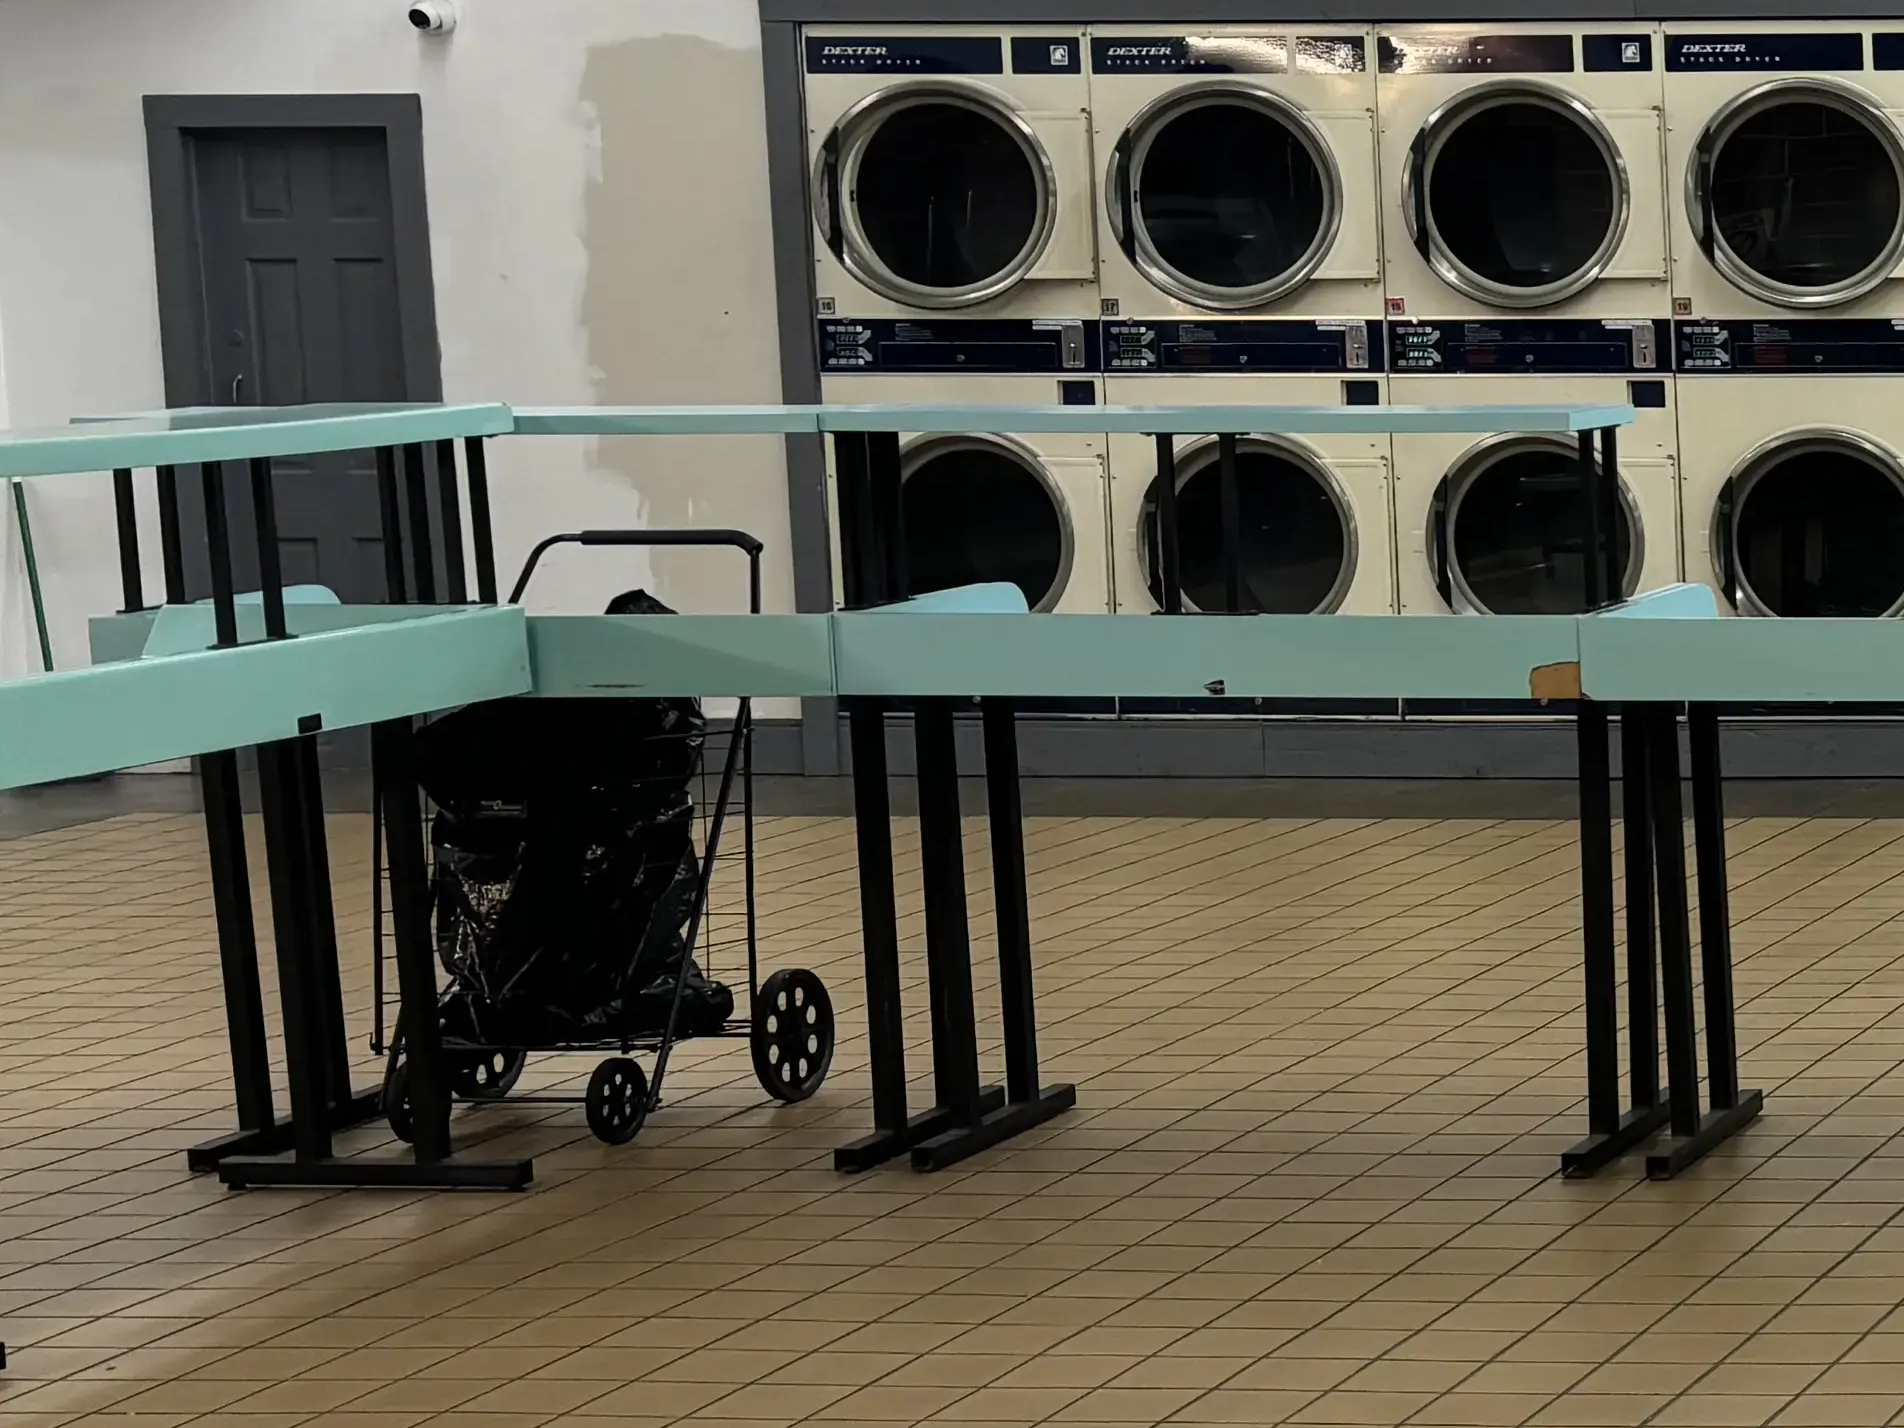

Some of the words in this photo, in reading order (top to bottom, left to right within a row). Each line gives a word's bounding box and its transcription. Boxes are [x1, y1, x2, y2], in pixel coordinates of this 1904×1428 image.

[822, 46, 887, 56] DEXTER
[1107, 46, 1172, 56] DEXTER
[1681, 43, 1747, 53] DEXTER
